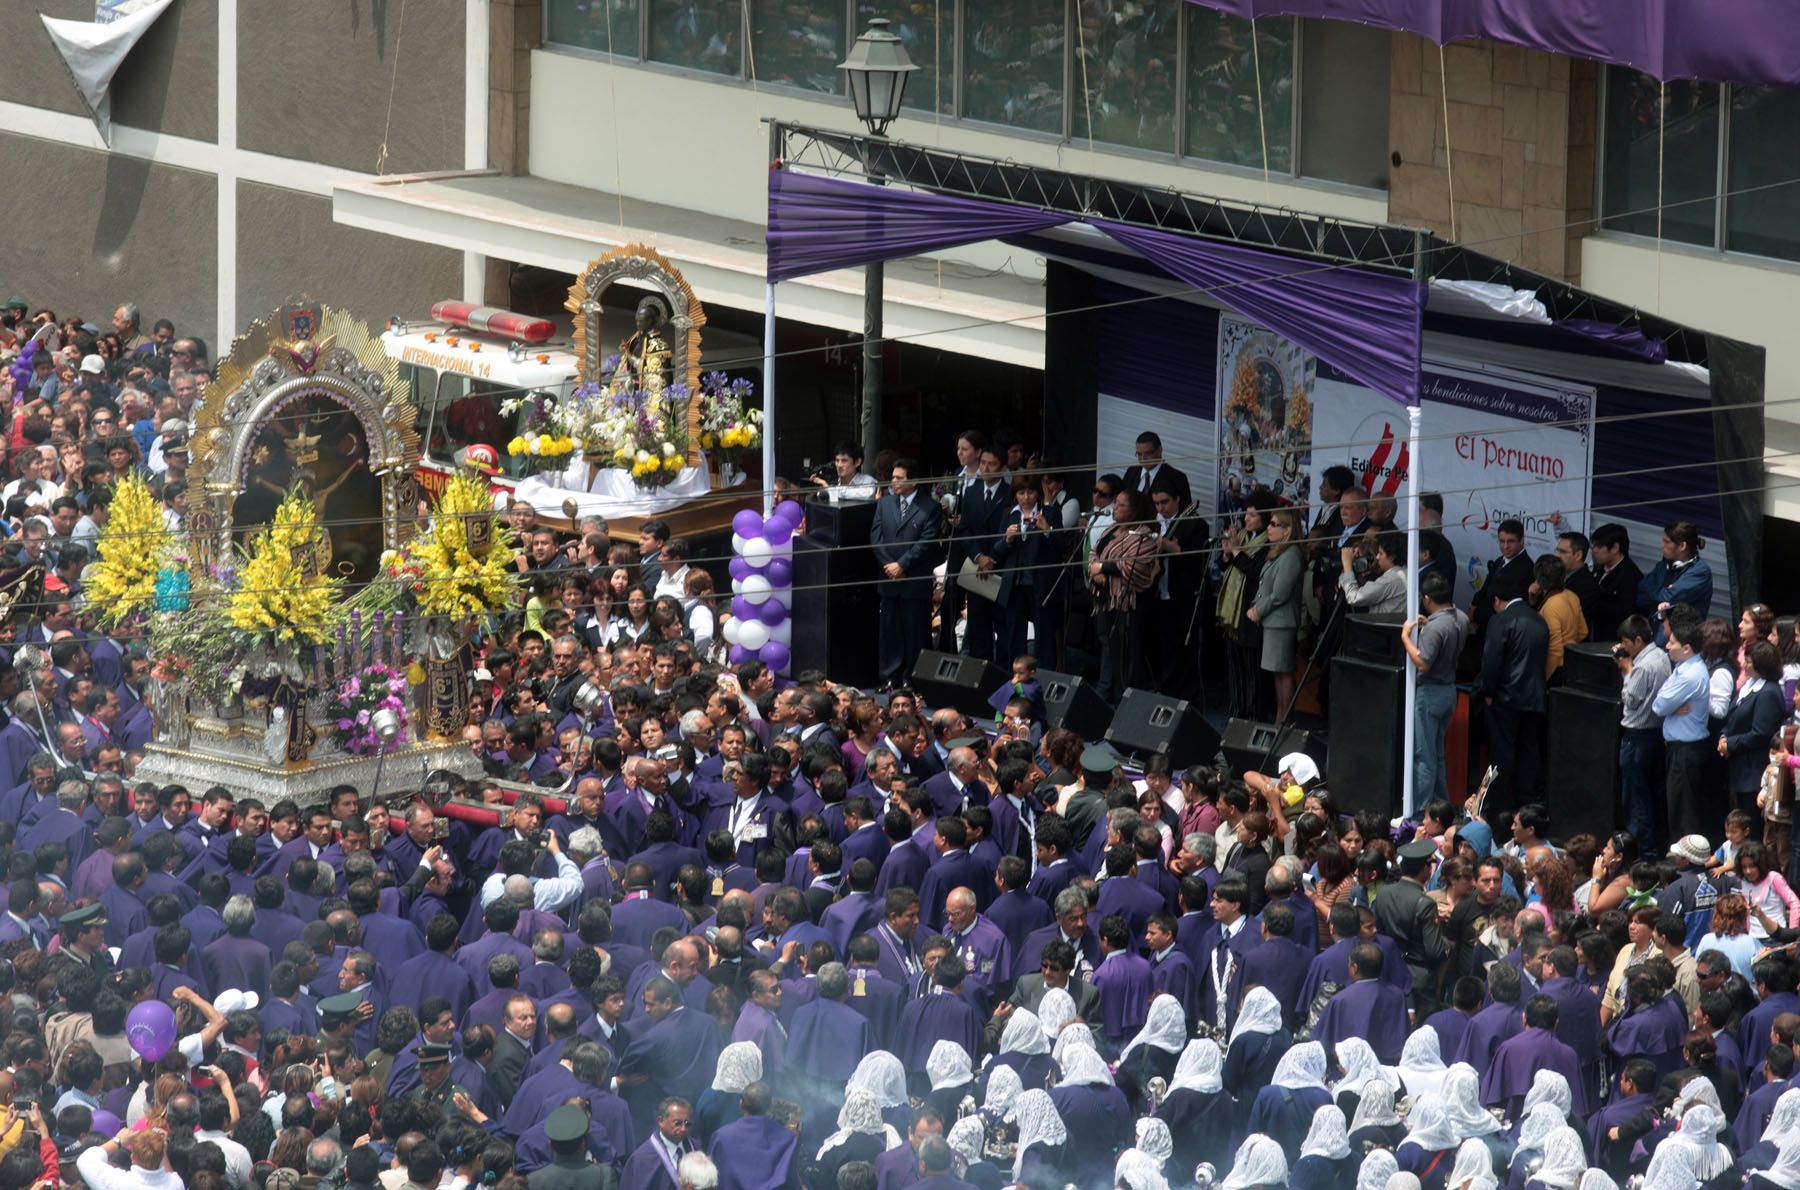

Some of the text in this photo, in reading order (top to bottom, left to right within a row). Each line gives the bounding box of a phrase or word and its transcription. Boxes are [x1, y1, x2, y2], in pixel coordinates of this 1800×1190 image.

[402, 345, 491, 378] INTERNACIONAL 14
[1432, 378, 1489, 407] bendiciones
[1490, 391, 1515, 412] sobre
[1517, 404, 1560, 421] nosotros
[1351, 457, 1392, 479] Editora
[1455, 434, 1564, 479] El Peruano
